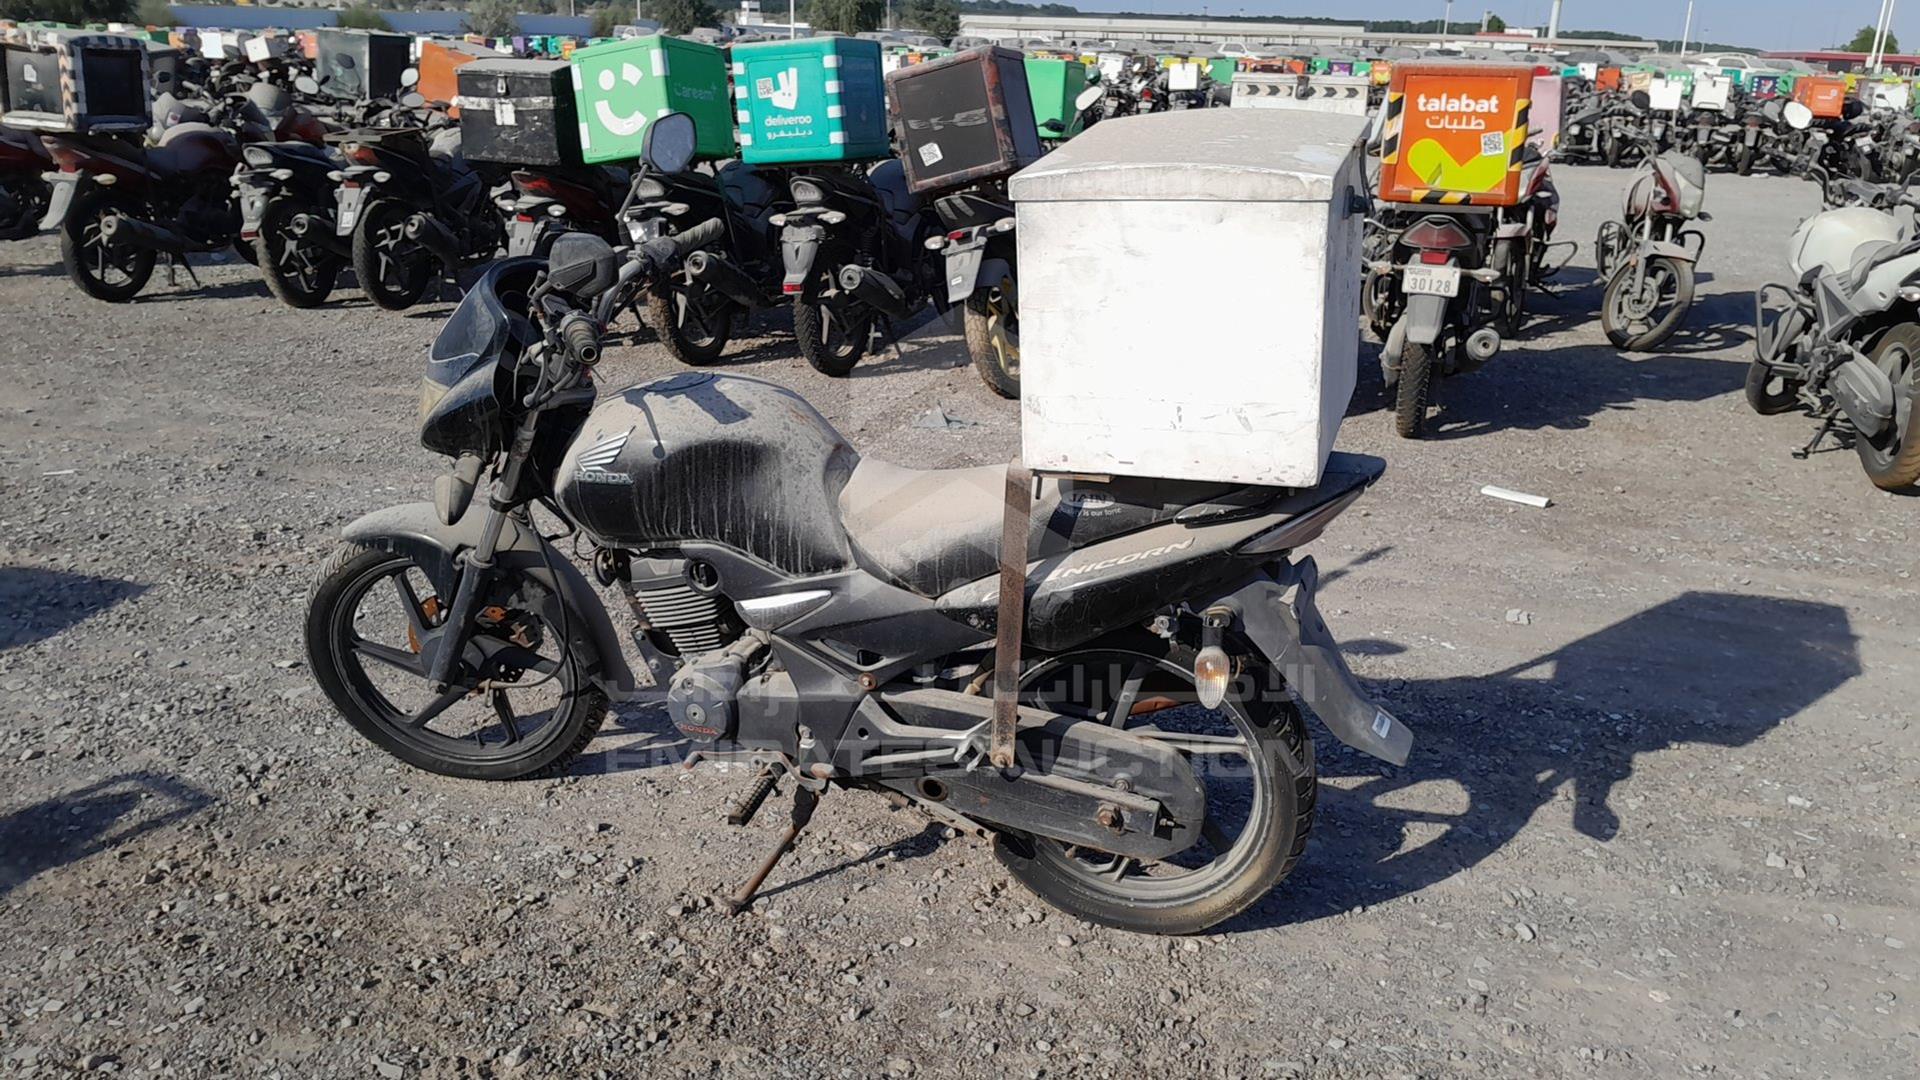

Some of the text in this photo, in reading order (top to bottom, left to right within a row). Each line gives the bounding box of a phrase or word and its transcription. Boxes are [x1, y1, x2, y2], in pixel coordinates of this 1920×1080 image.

[1417, 92, 1499, 113] talabat
[765, 115, 812, 127] deliveroo
[1425, 114, 1486, 133] طلبات
[1410, 277, 1452, 293] 30128
[574, 470, 634, 485] HONDA
[678, 722, 719, 737] HONDA
